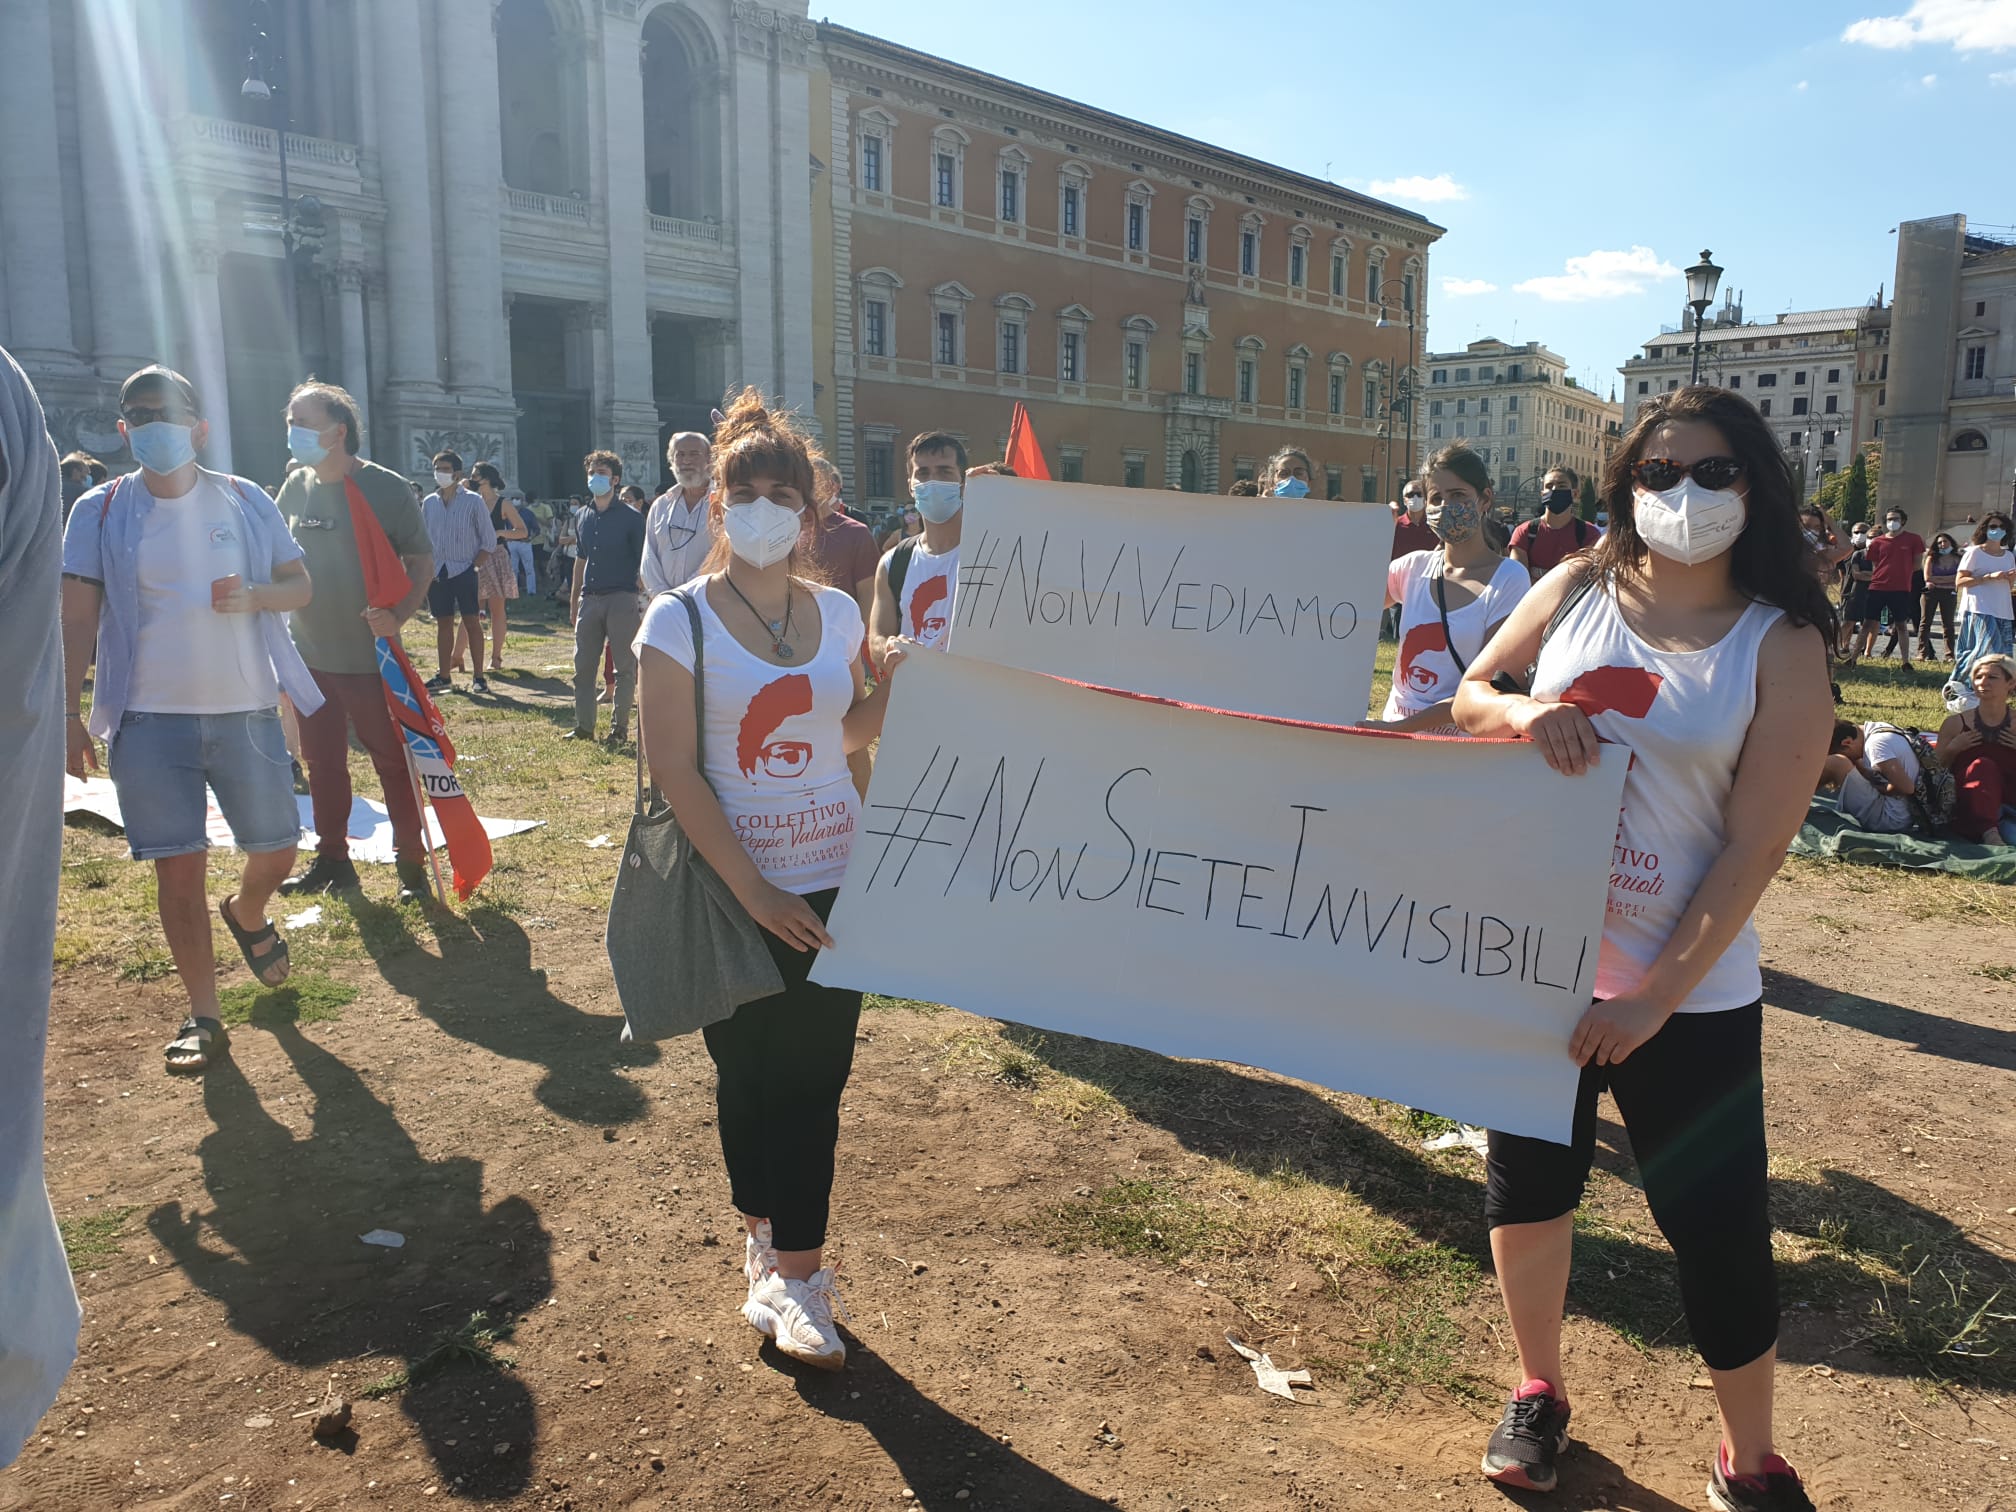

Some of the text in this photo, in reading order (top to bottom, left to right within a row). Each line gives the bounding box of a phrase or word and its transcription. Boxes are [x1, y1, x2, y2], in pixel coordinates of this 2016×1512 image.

[735, 801, 846, 829] COLLETTIVO
[734, 812, 854, 854] Peppe Valarioti
